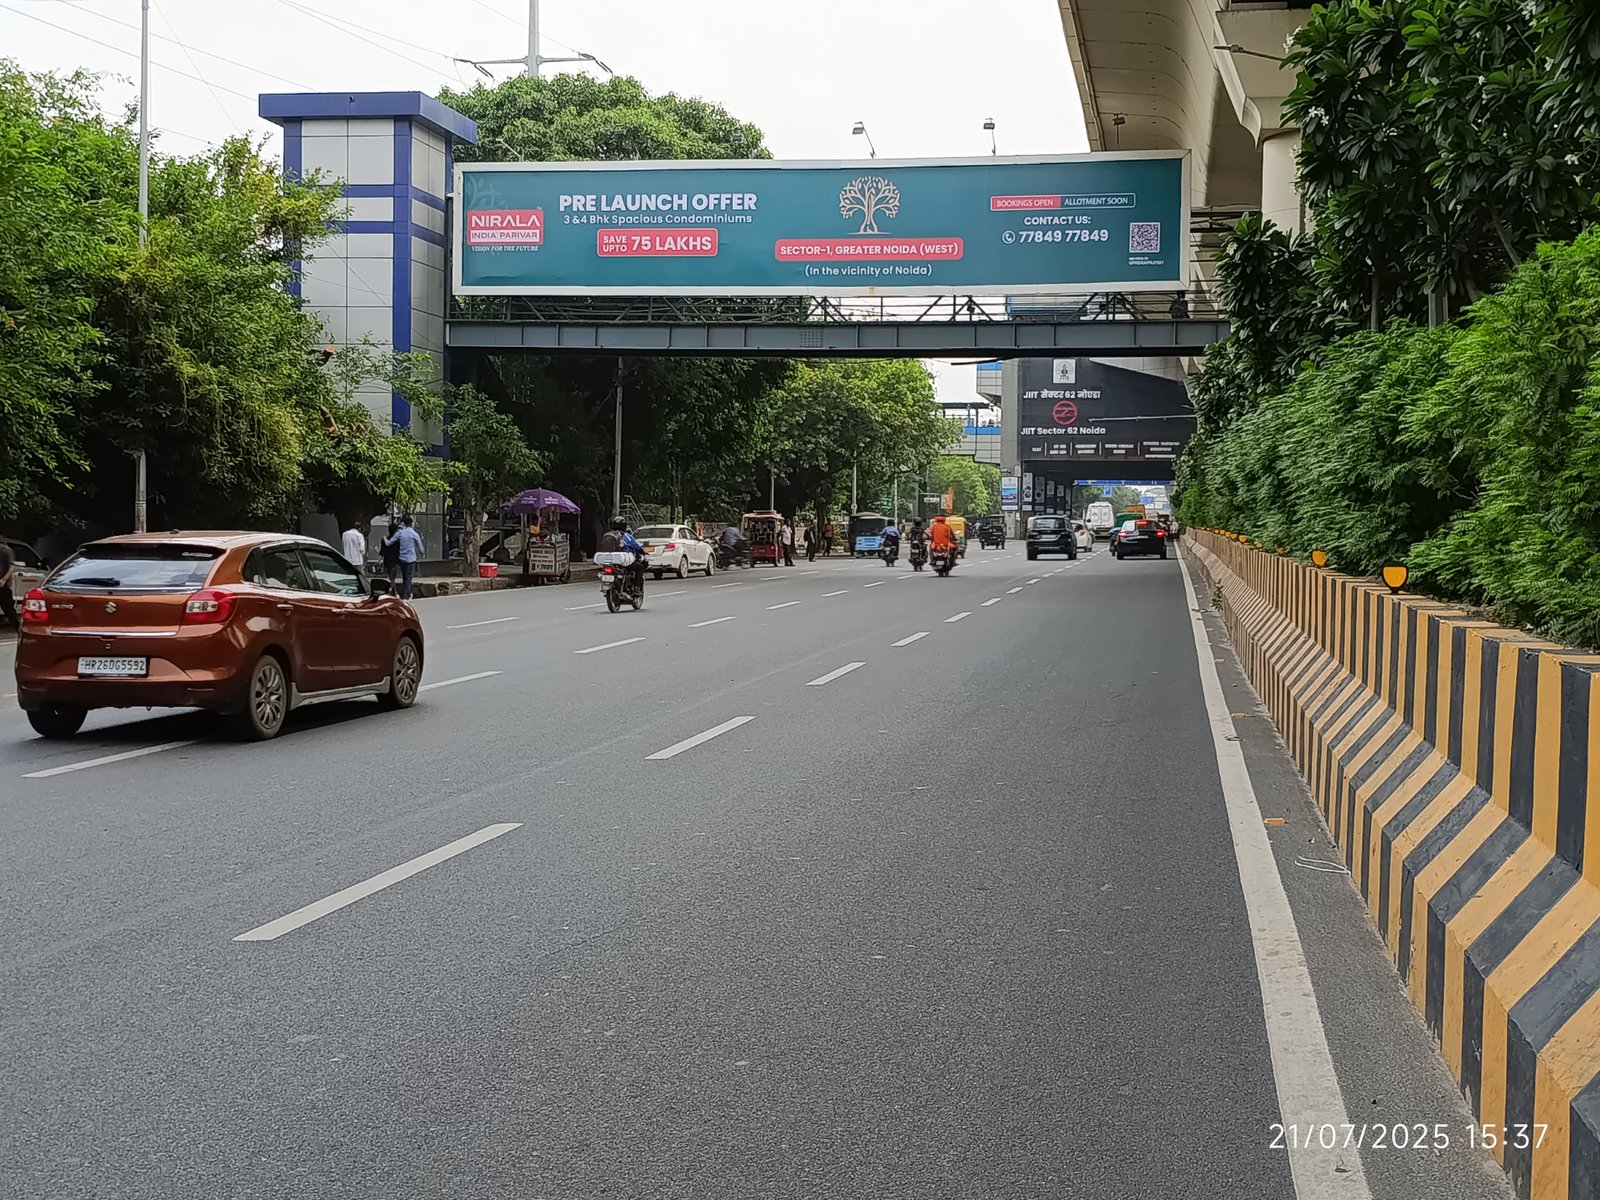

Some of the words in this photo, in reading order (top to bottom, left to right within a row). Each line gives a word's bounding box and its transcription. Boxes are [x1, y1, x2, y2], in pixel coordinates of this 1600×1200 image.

[559, 195, 596, 212] PRE
[600, 194, 688, 211] LAUNCH
[692, 193, 758, 211] OFFER
[996, 199, 1033, 207] BOOKINGS
[1034, 198, 1054, 207] OPEN
[1064, 197, 1106, 206] ALLOTMENT
[1107, 197, 1128, 205] SOON
[471, 214, 541, 227] NIRALA
[563, 215, 570, 224] 3
[589, 214, 610, 224] Bhk
[611, 214, 663, 226] Spacious
[665, 213, 753, 224] Condominiums
[1024, 216, 1073, 225] CONTACT
[1075, 215, 1092, 224] US:
[499, 231, 538, 239] PARIVAR
[603, 235, 627, 244] SAVE
[1018, 230, 1062, 243] 77849
[1065, 229, 1109, 242] 77849
[602, 244, 627, 253] UPTO
[631, 236, 652, 251] 75
[655, 236, 713, 251] LAKHS
[780, 244, 834, 257] SECTOR-1,
[835, 244, 882, 256] GREATER
[883, 243, 917, 255] NOIDA
[919, 241, 960, 256] (WEST)
[804, 265, 820, 278] (In
[821, 265, 839, 277] the
[840, 265, 880, 278] vicinity
[881, 265, 894, 276] of
[895, 263, 933, 278] Noida)
[1065, 391, 1076, 399] 62
[1036, 427, 1066, 436] Sector
[1067, 427, 1078, 435] 62
[1079, 426, 1106, 435] Noida
